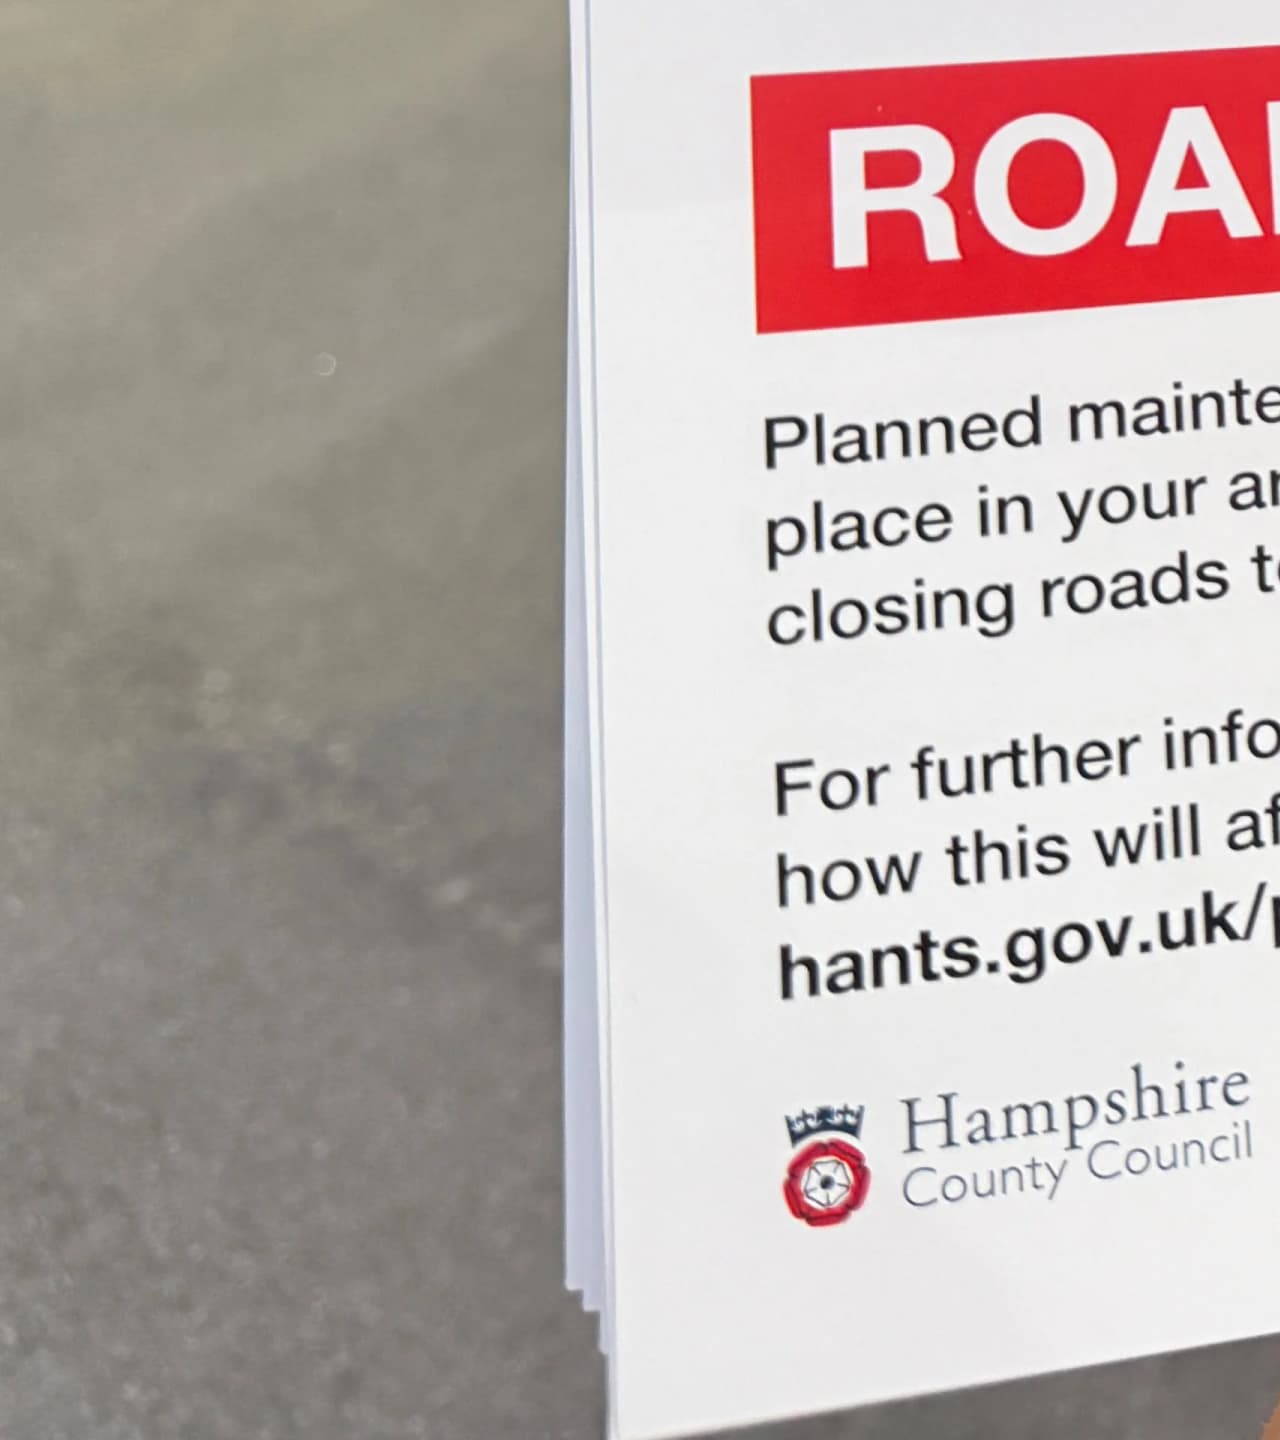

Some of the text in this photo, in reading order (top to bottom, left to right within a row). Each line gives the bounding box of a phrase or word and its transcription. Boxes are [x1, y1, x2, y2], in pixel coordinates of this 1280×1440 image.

[766, 395, 1040, 469] Planned
[768, 501, 952, 570] place
[979, 486, 1032, 536] in
[1058, 477, 1206, 542] your
[769, 579, 1013, 644] closing
[1042, 551, 1228, 616] roads
[776, 760, 889, 815] For
[911, 734, 1140, 799] further
[778, 853, 920, 907] how
[946, 830, 1069, 885] this
[1094, 804, 1199, 867] will
[901, 1062, 1251, 1151] Hampshire
[903, 1121, 1254, 1206] County Council
